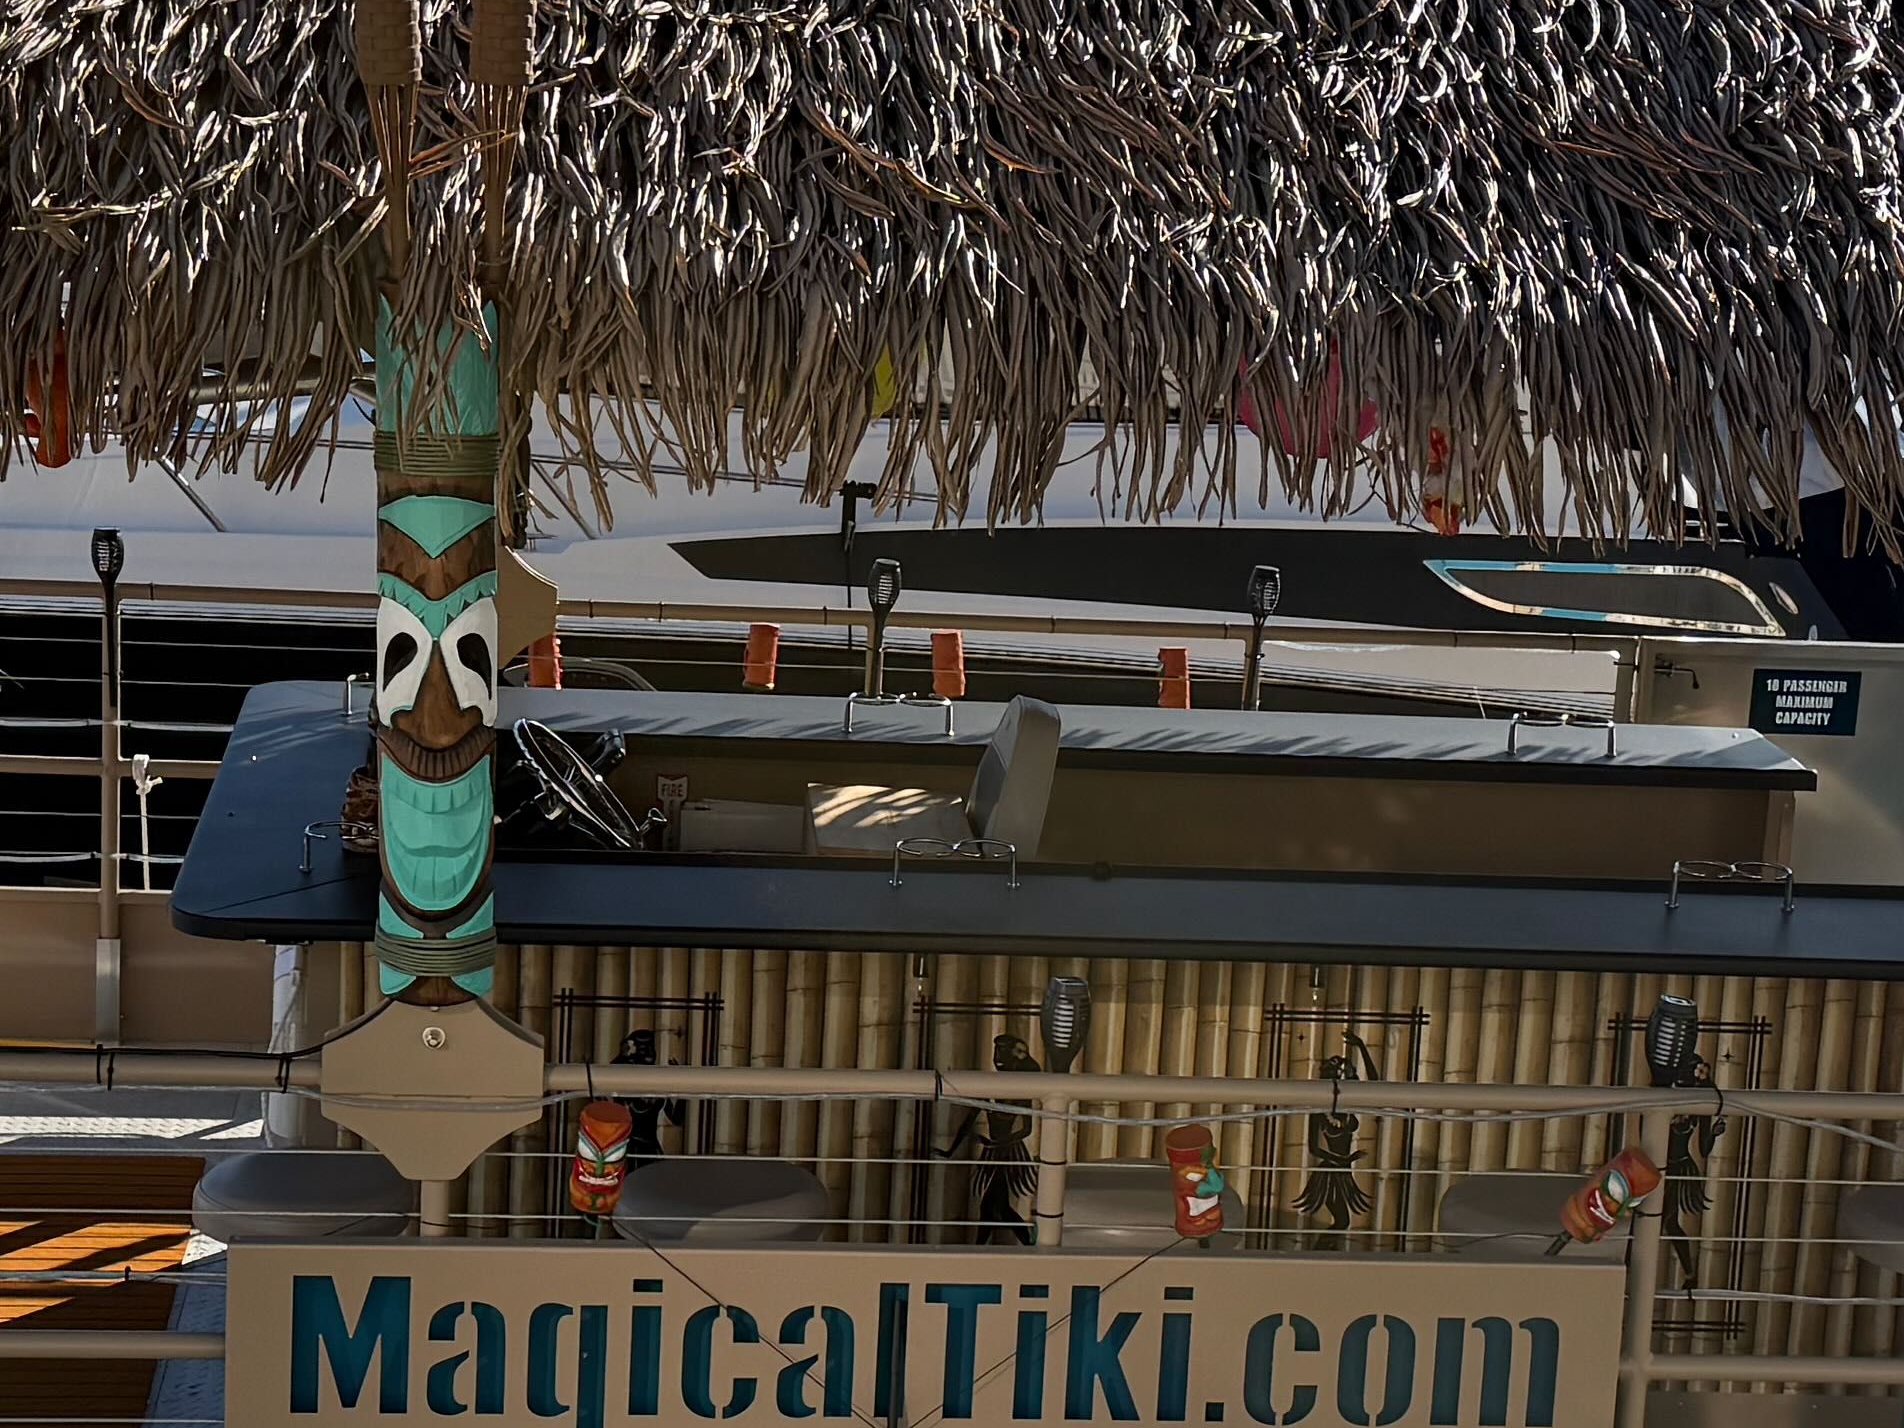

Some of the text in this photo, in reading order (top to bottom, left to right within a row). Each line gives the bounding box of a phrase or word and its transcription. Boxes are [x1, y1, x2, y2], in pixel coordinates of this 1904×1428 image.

[1783, 679, 1848, 694] PASSENGER
[1775, 695, 1834, 709] MAXIMUM
[1775, 711, 1831, 726] CAPACITY
